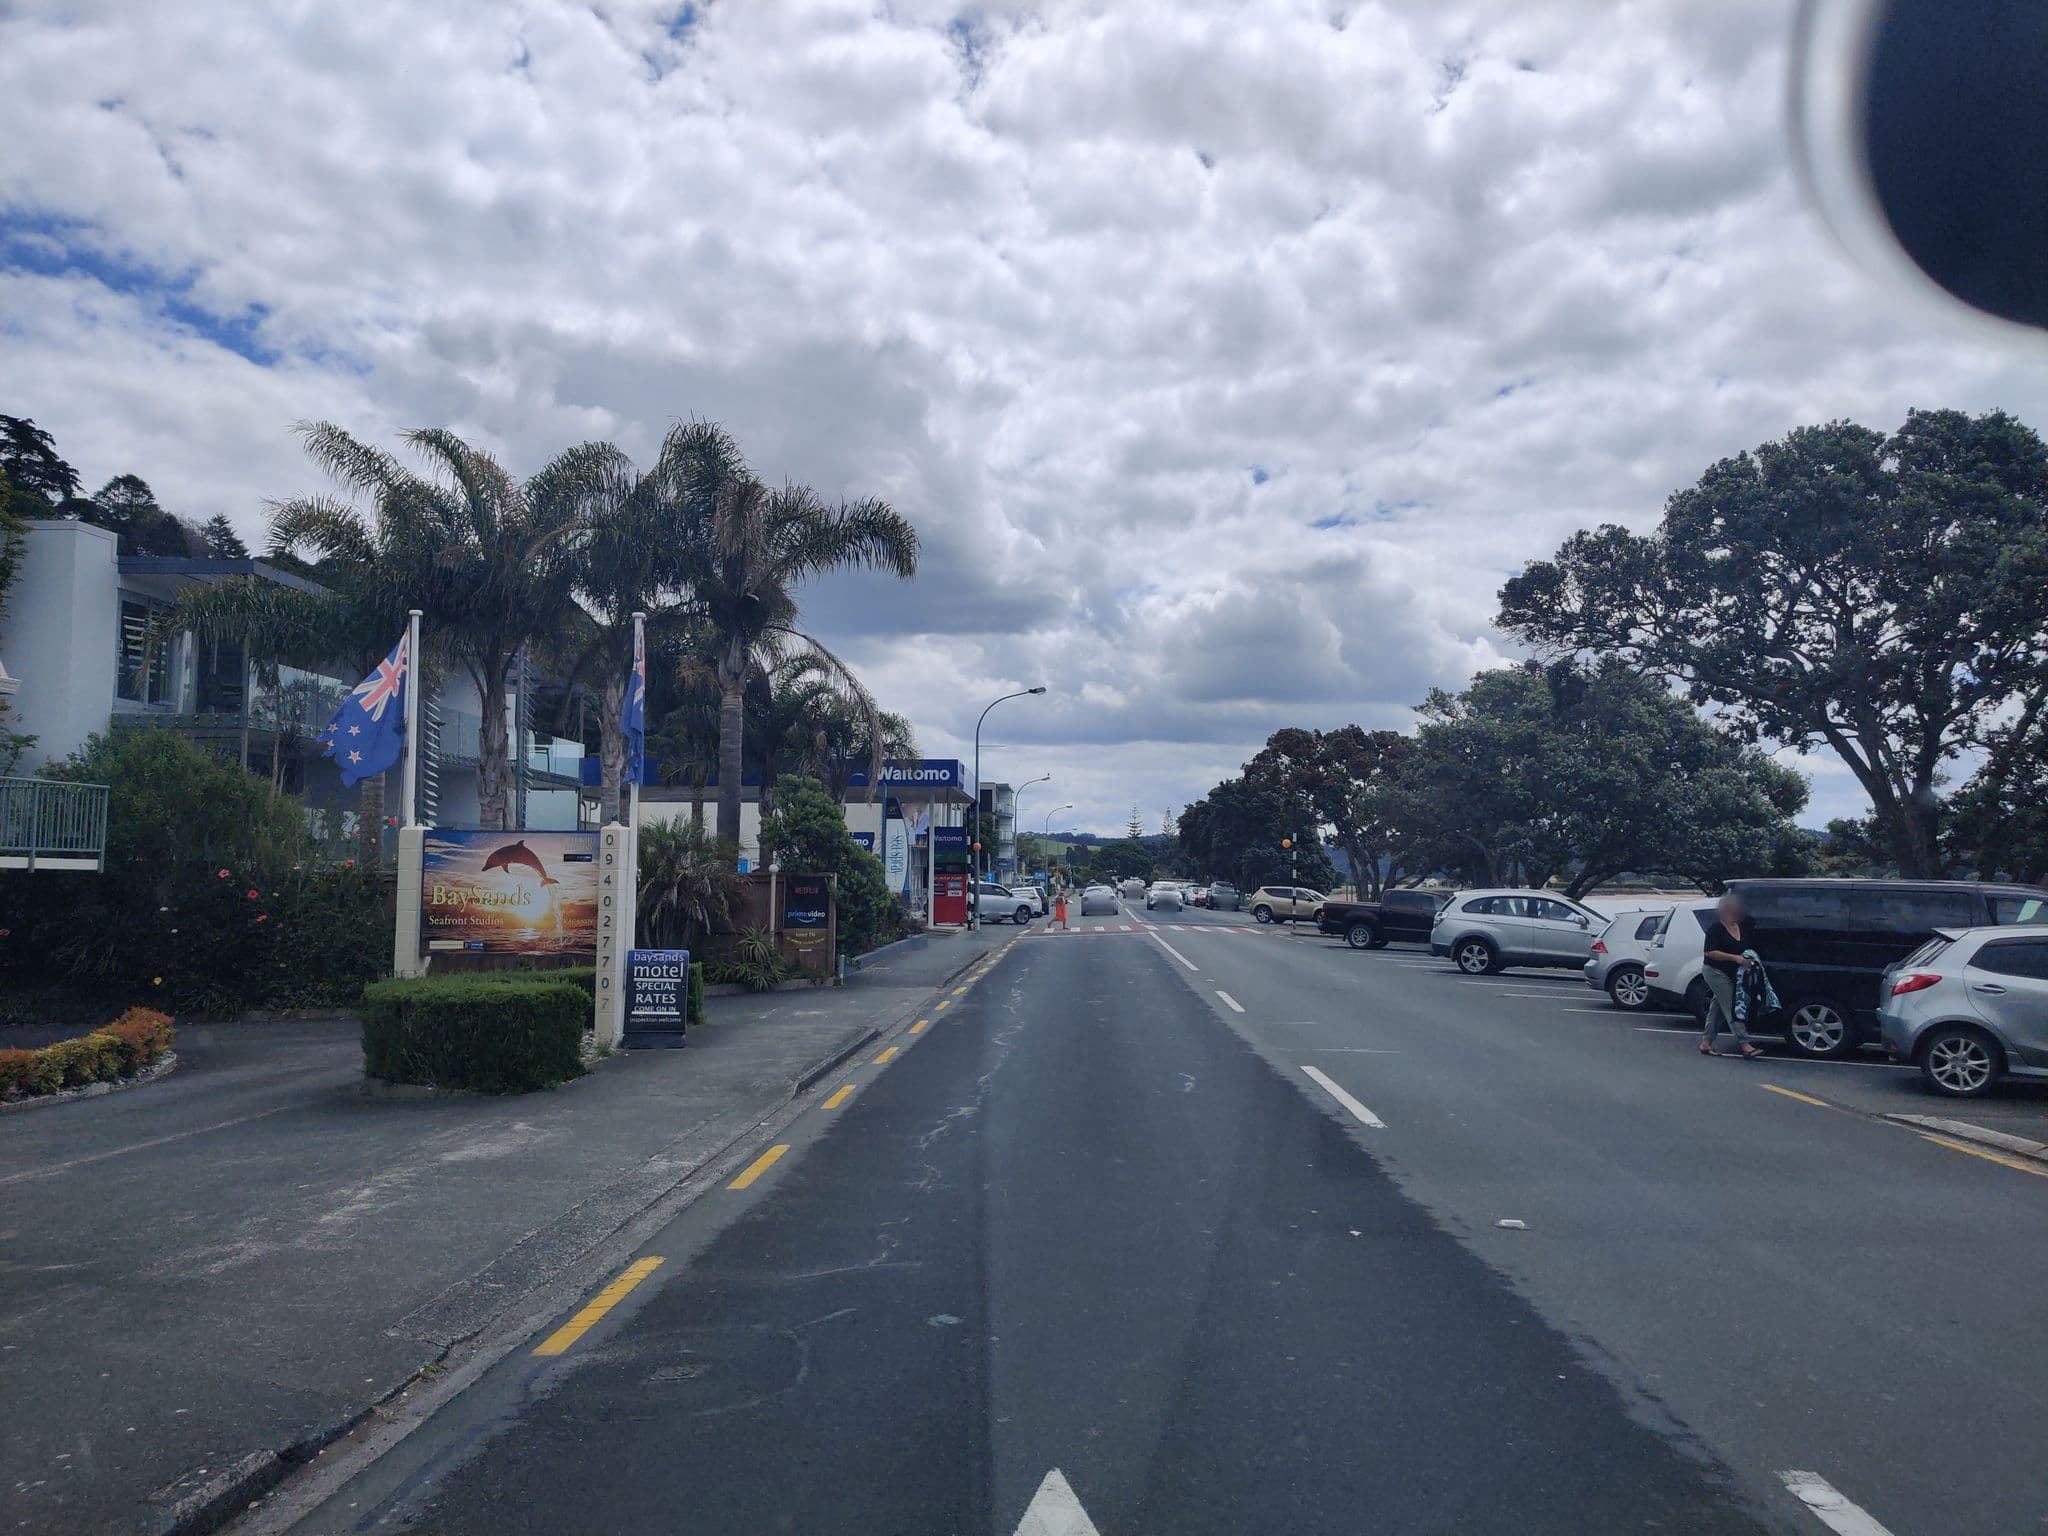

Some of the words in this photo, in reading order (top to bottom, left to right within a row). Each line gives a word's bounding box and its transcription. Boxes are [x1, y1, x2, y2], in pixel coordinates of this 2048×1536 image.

[878, 766, 951, 781] Waitomo
[787, 910, 807, 918] prime
[429, 915, 467, 926] Seafront
[470, 915, 504, 926] Studios
[634, 951, 684, 963] baysands
[633, 962, 684, 978] motel
[636, 982, 677, 991] SPECIAL
[636, 993, 676, 1004] RATES
